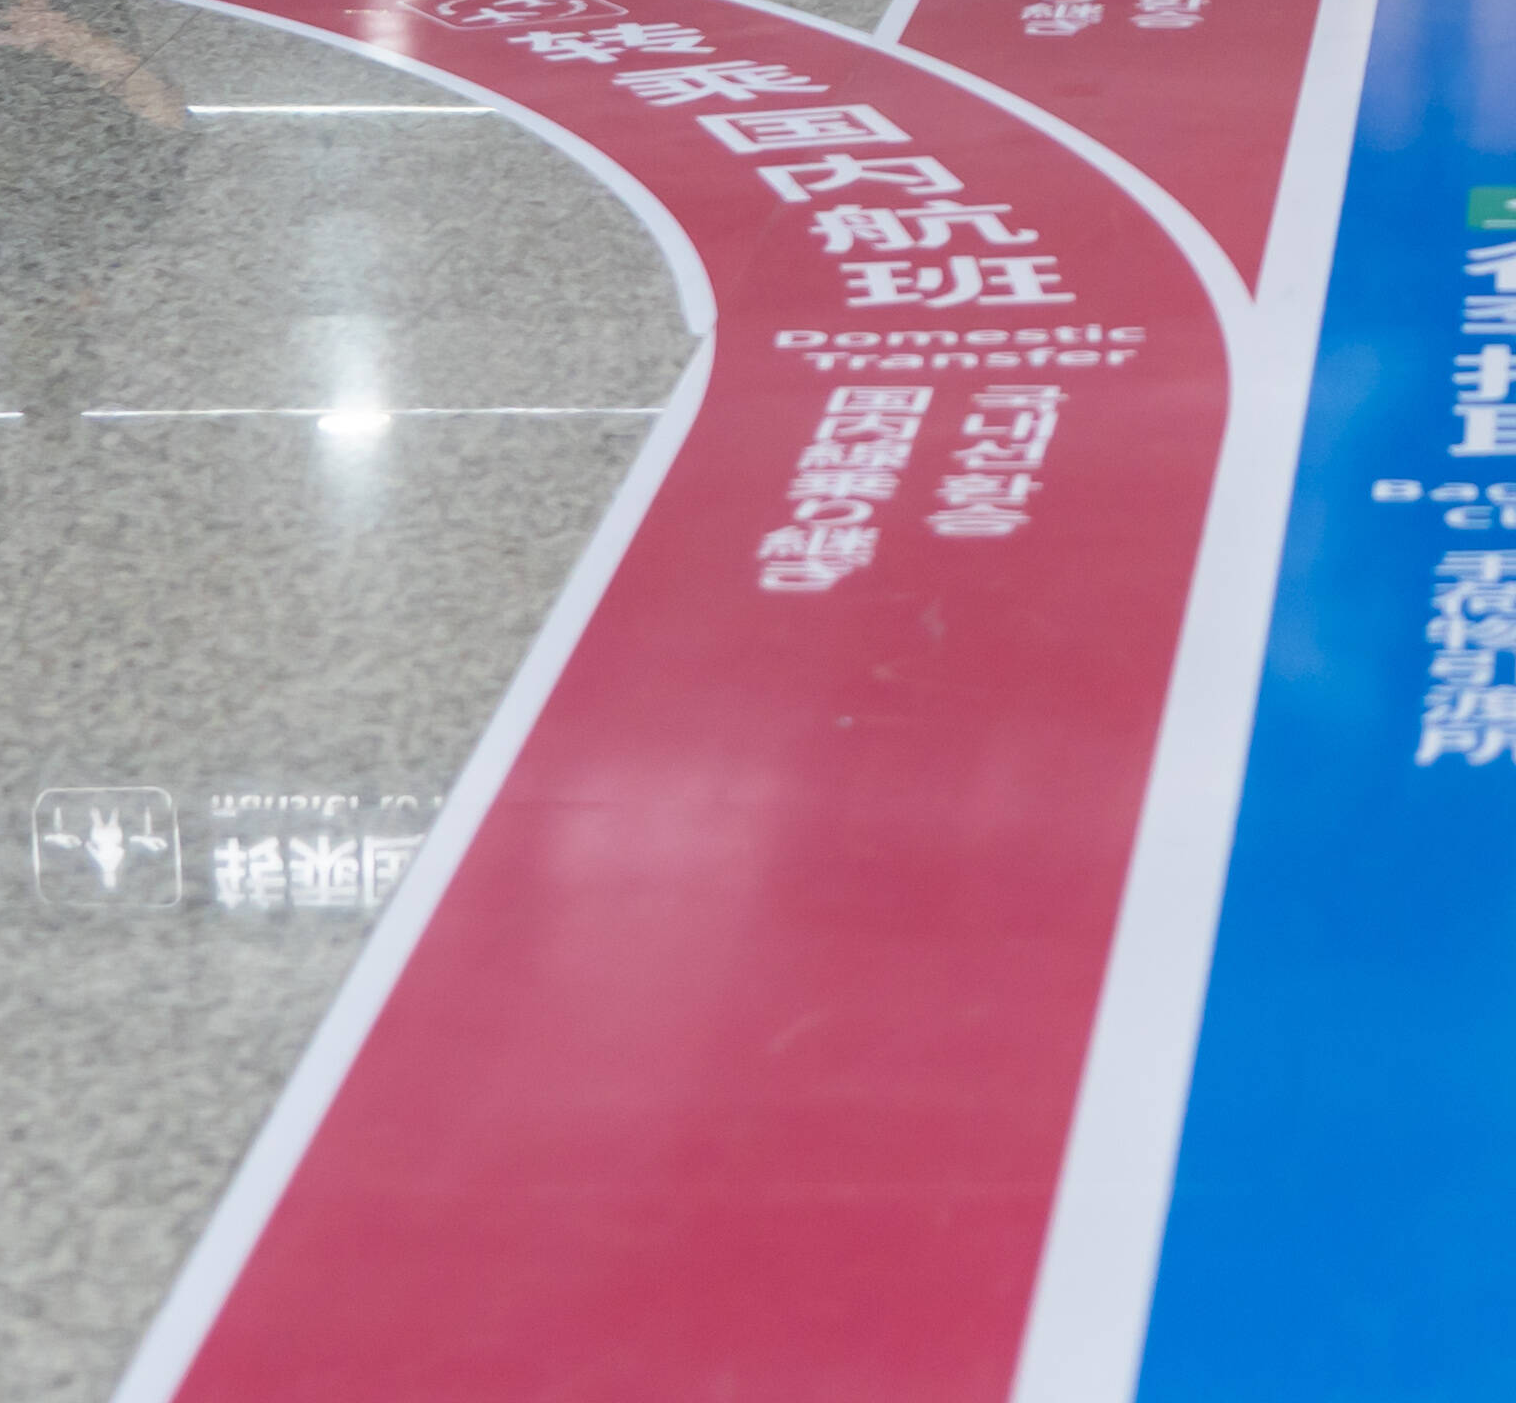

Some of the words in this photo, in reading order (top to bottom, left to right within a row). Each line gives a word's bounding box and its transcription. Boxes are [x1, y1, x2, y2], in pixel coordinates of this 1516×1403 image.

[506, 21, 1078, 309] 转乘国内航班
[774, 324, 1148, 351] Domestic
[804, 344, 1140, 371] Transfer
